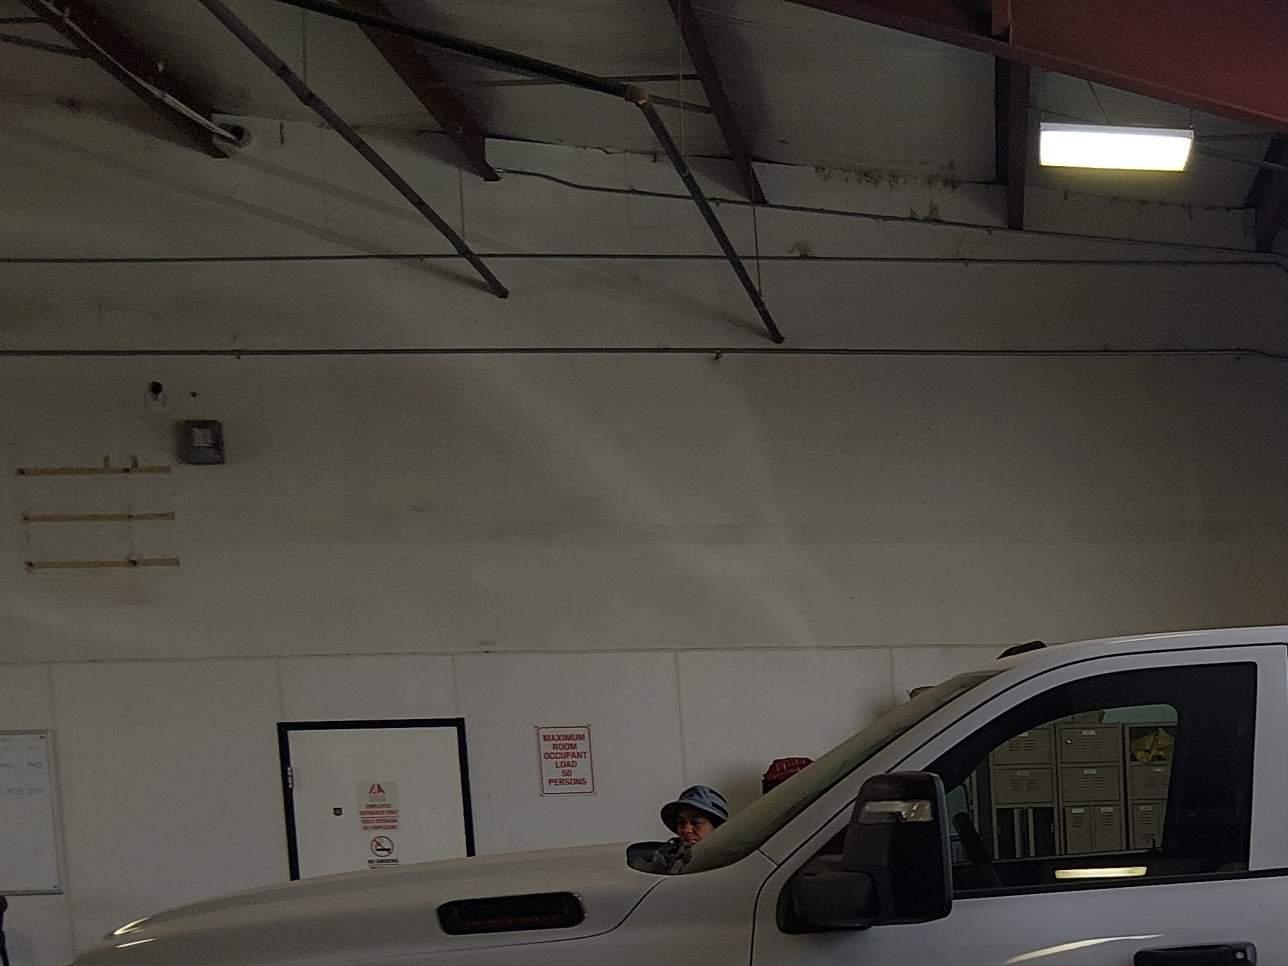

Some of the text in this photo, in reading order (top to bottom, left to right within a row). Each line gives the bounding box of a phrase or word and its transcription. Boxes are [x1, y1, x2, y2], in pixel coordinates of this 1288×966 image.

[543, 733, 585, 742] MAXIMUM
[552, 743, 578, 751] ROOM
[543, 751, 587, 760] OCCUPANT
[555, 760, 578, 769] LOAD
[561, 769, 573, 777] 50
[548, 778, 588, 786] PERSONS
